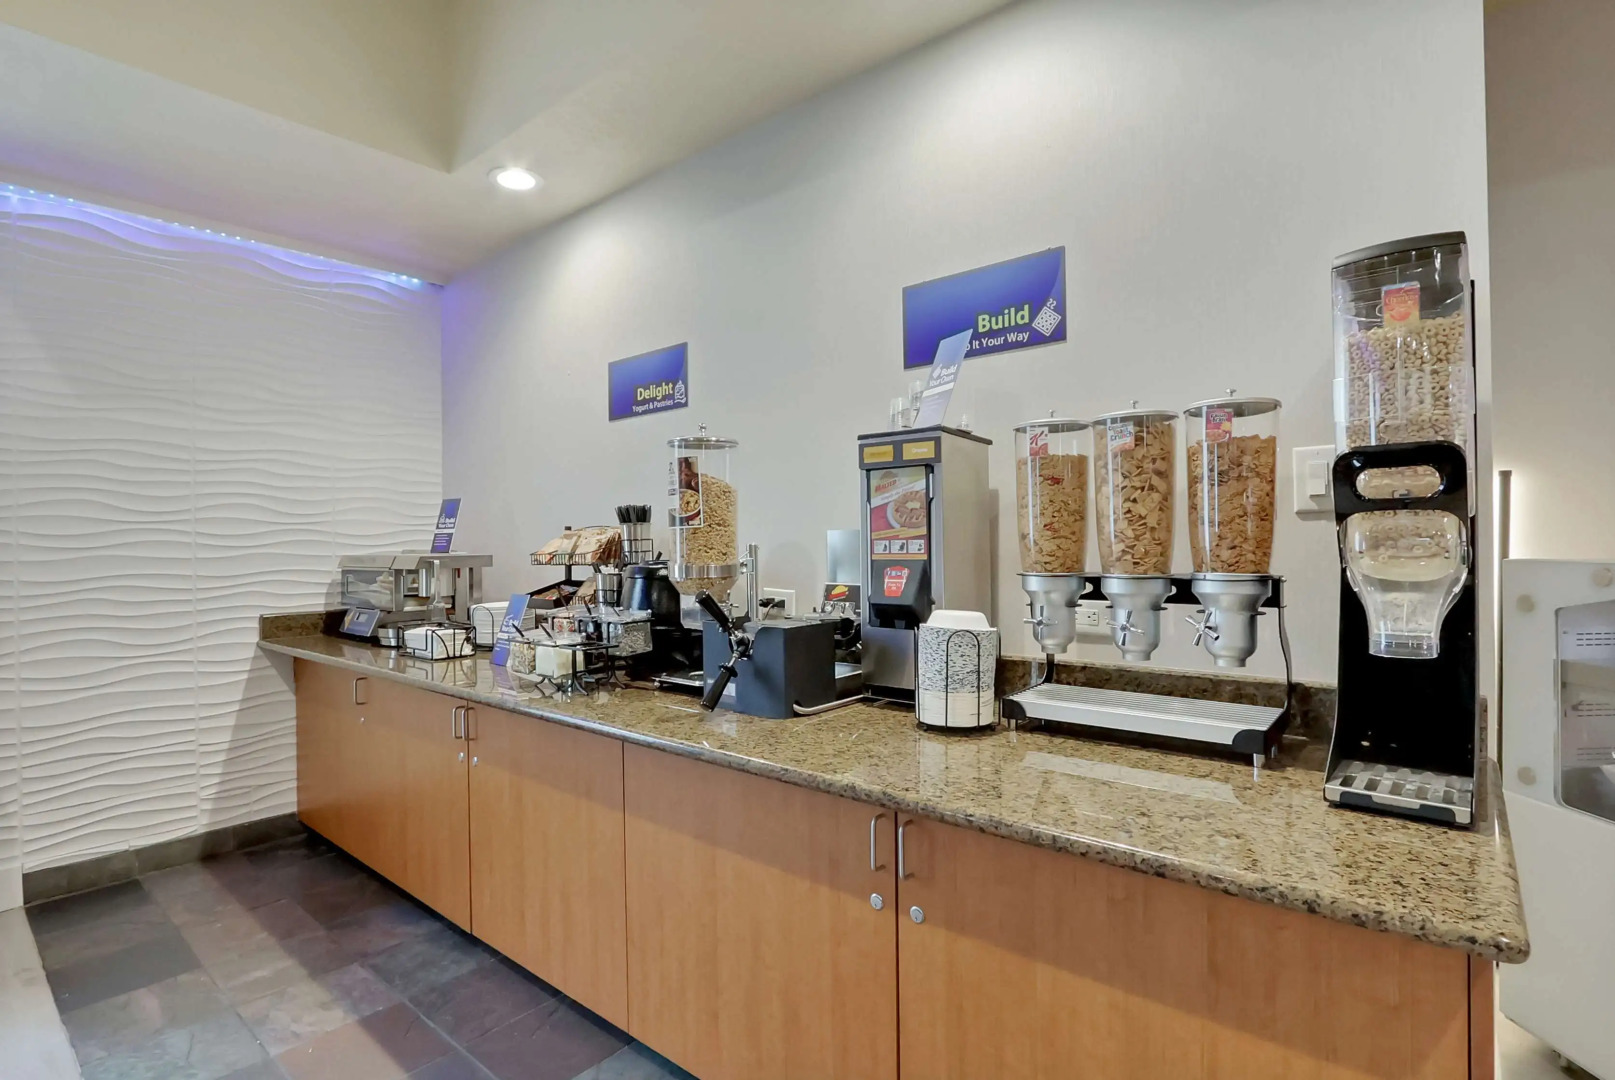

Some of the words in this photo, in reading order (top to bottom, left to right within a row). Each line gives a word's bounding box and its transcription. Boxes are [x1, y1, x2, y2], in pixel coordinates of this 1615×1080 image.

[978, 304, 1030, 333] Build
[972, 340, 980, 350] It
[981, 336, 1005, 348] Your
[1006, 331, 1030, 343] Way
[940, 364, 958, 377] Build
[637, 382, 673, 401] Delight
[632, 403, 649, 413] Yogurt
[649, 401, 654, 410] &
[654, 399, 674, 409] Pastries
[1030, 430, 1045, 446] K
